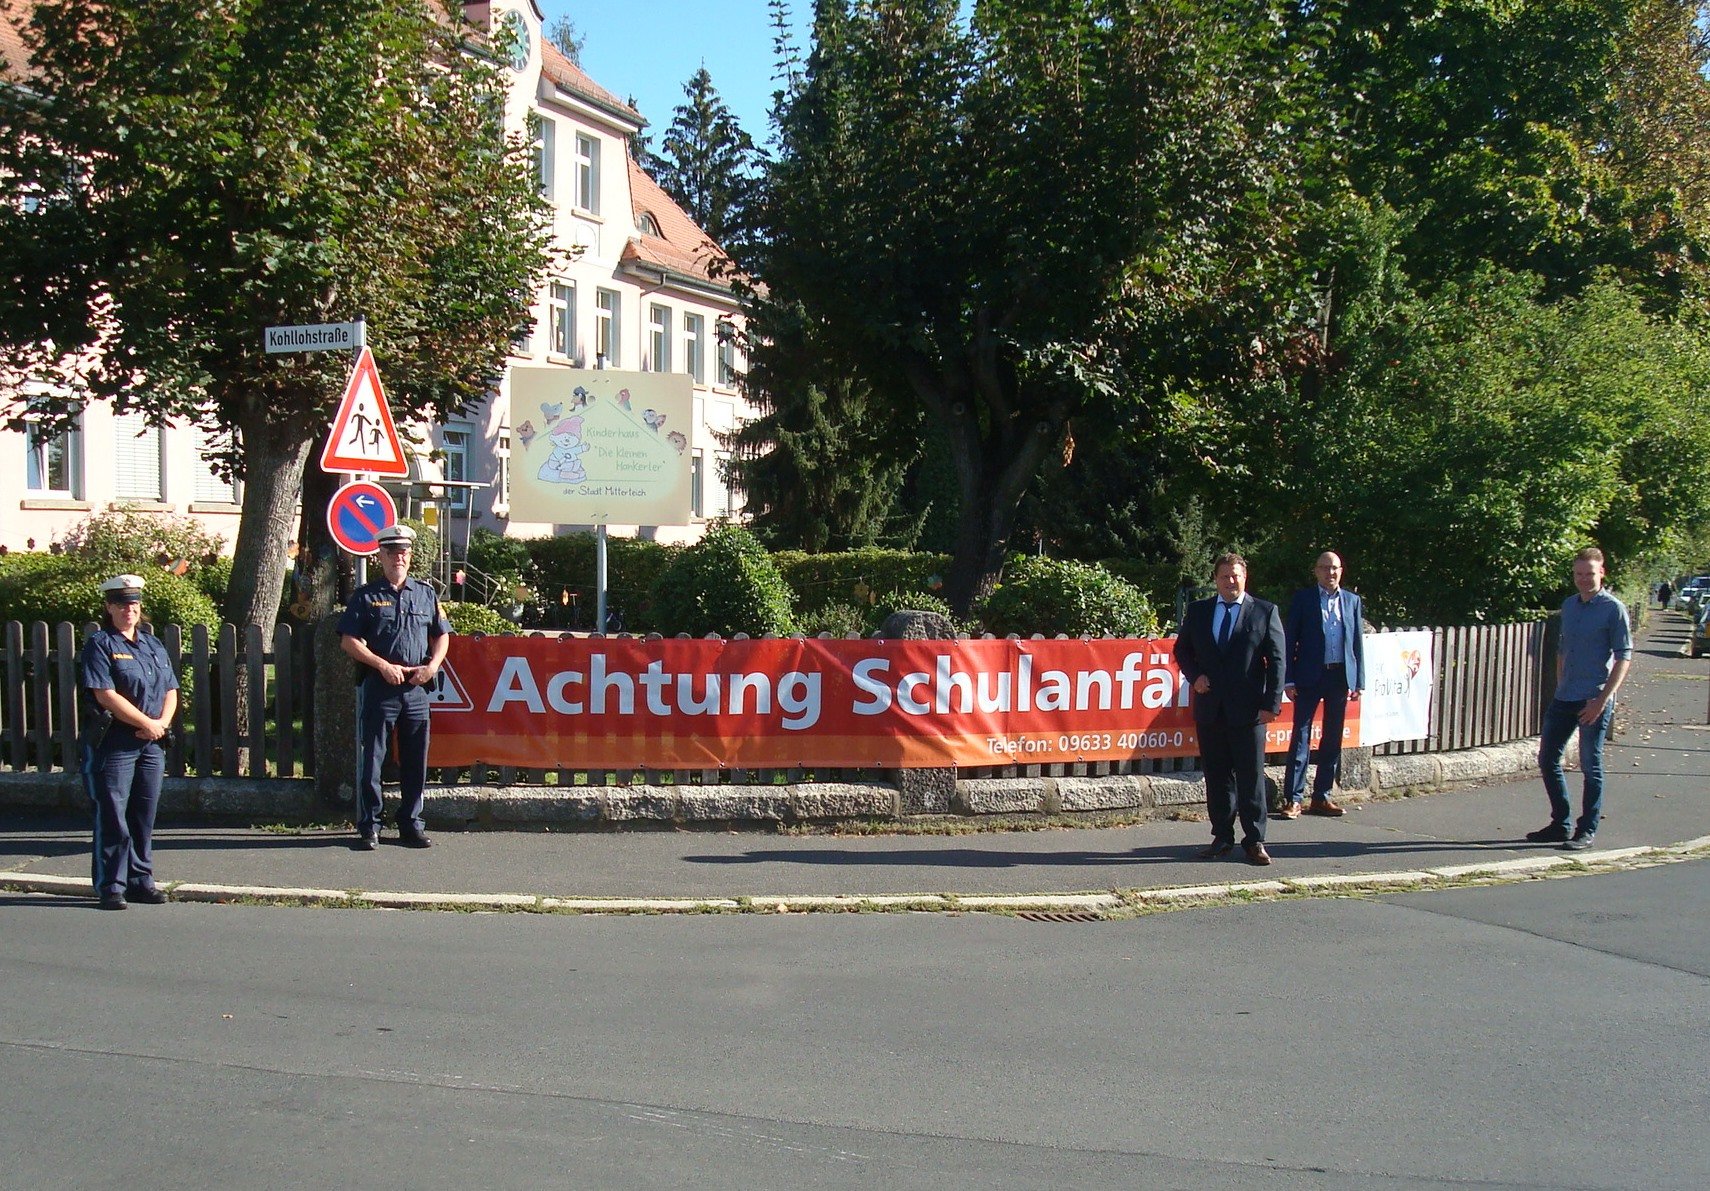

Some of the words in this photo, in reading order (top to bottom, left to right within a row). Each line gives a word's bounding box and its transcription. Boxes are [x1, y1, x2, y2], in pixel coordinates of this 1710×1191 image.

[269, 327, 349, 347] Kohllohstraße
[586, 427, 640, 438] Kinderhaus
[562, 487, 575, 496] der
[578, 485, 602, 496] Stadt
[604, 486, 647, 497] Mitterteich
[486, 653, 823, 731] Achtung
[986, 734, 1053, 754] Telefon:
[1058, 733, 1112, 752] 09633
[1116, 731, 1184, 750] 40060-0
